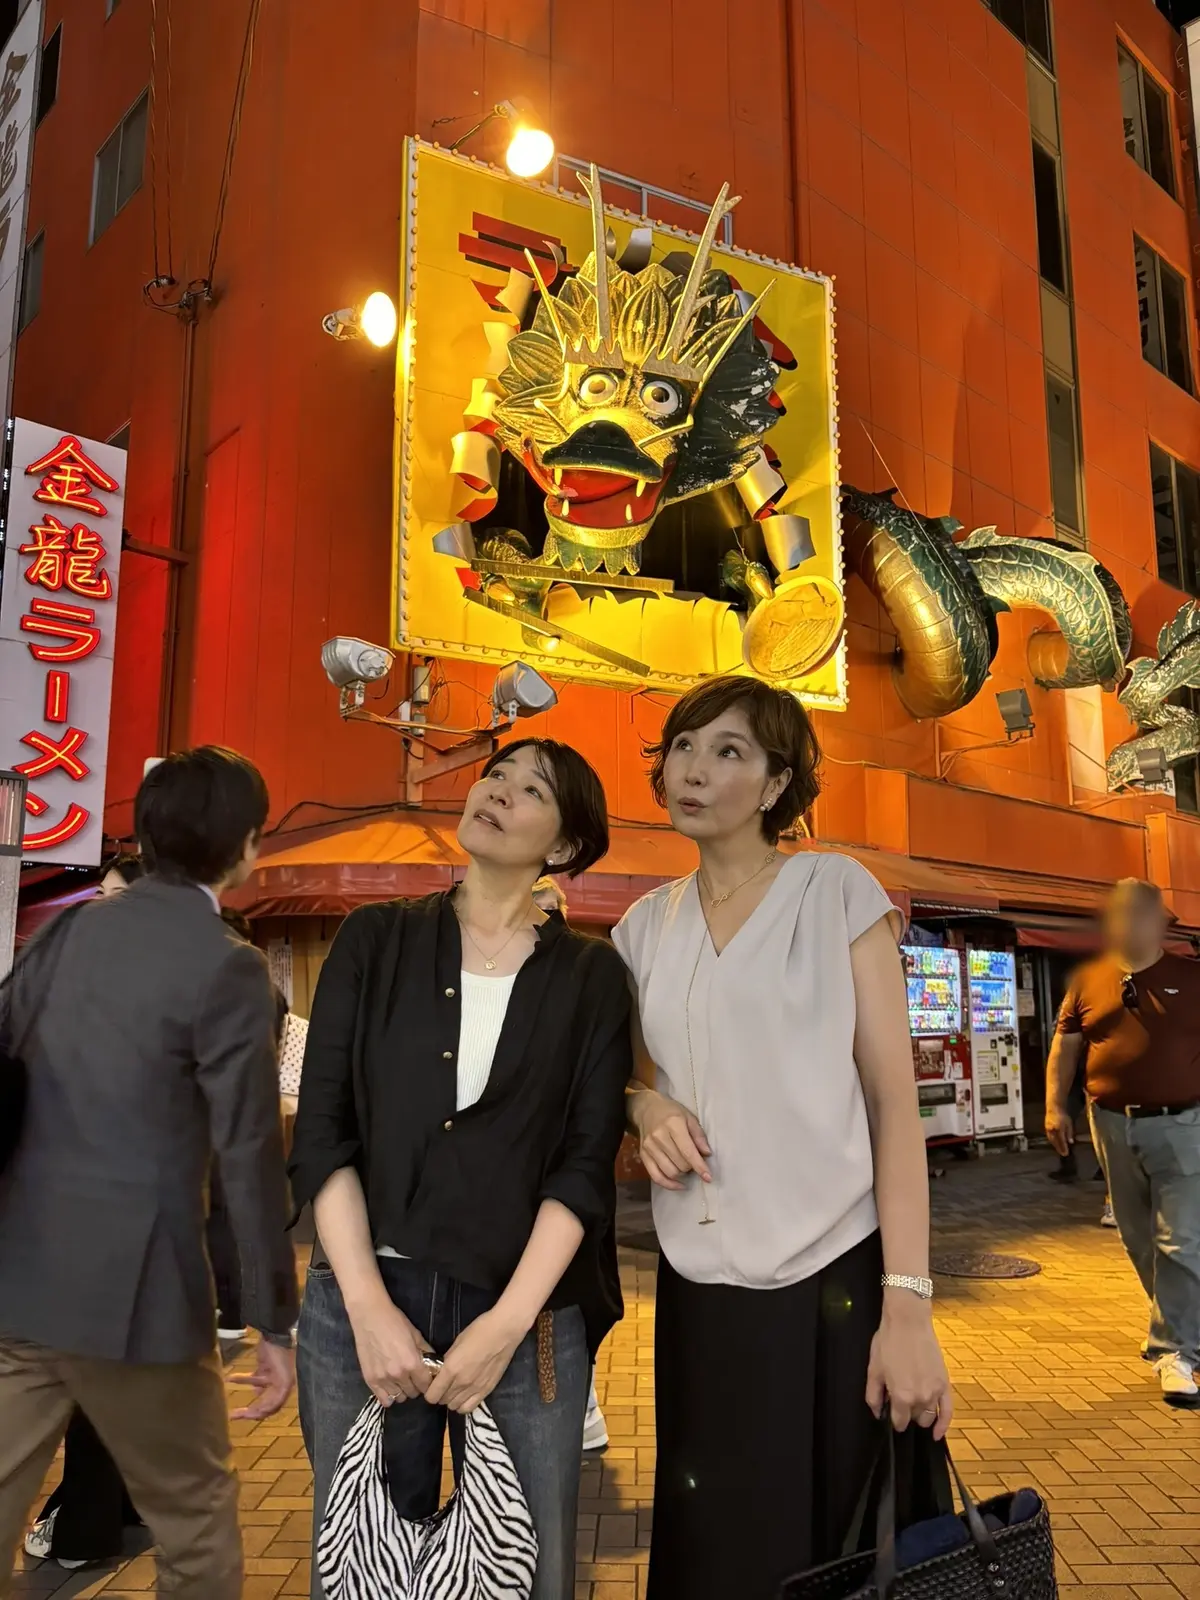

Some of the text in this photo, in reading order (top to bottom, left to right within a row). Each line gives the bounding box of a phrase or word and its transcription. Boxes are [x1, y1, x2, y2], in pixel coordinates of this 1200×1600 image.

[12, 435, 119, 850] 金龍ラーメン
